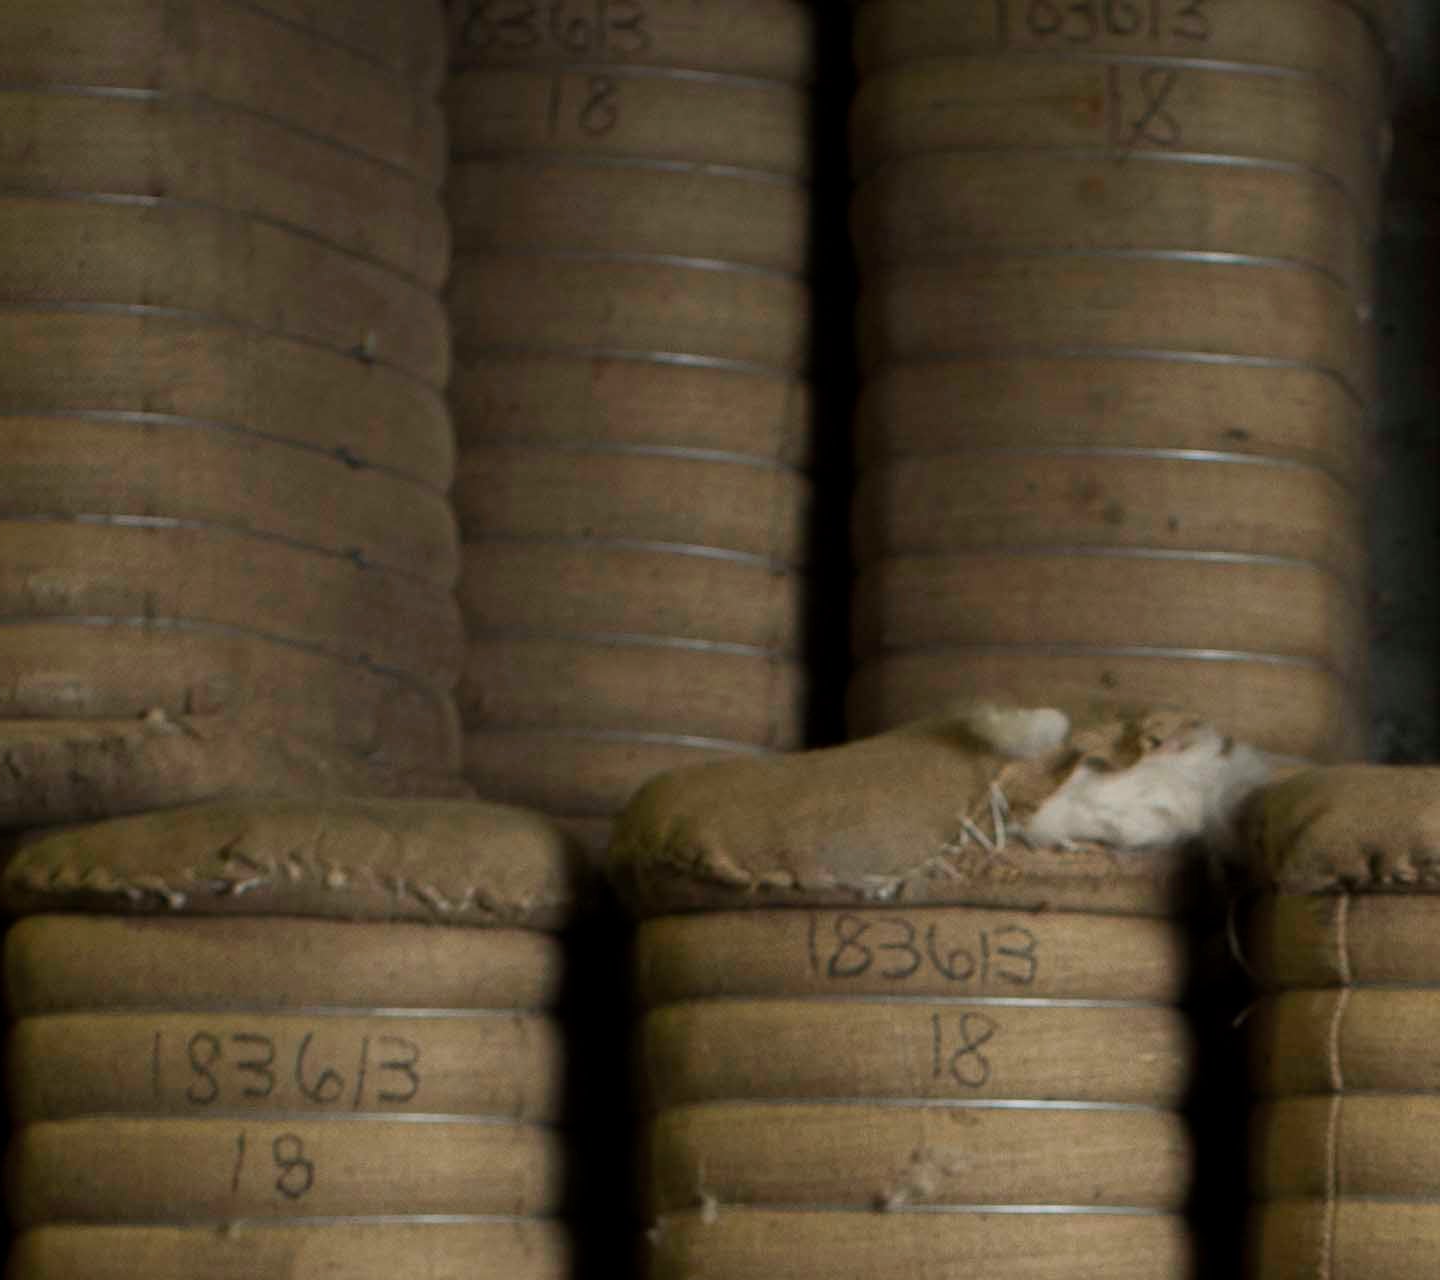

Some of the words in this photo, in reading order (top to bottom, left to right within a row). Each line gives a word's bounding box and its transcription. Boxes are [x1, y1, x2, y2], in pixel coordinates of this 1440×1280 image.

[807, 913, 1038, 986] 183613
[151, 1032, 422, 1110] 183613
[932, 1011, 998, 1088] 18
[231, 1128, 315, 1200] 18
